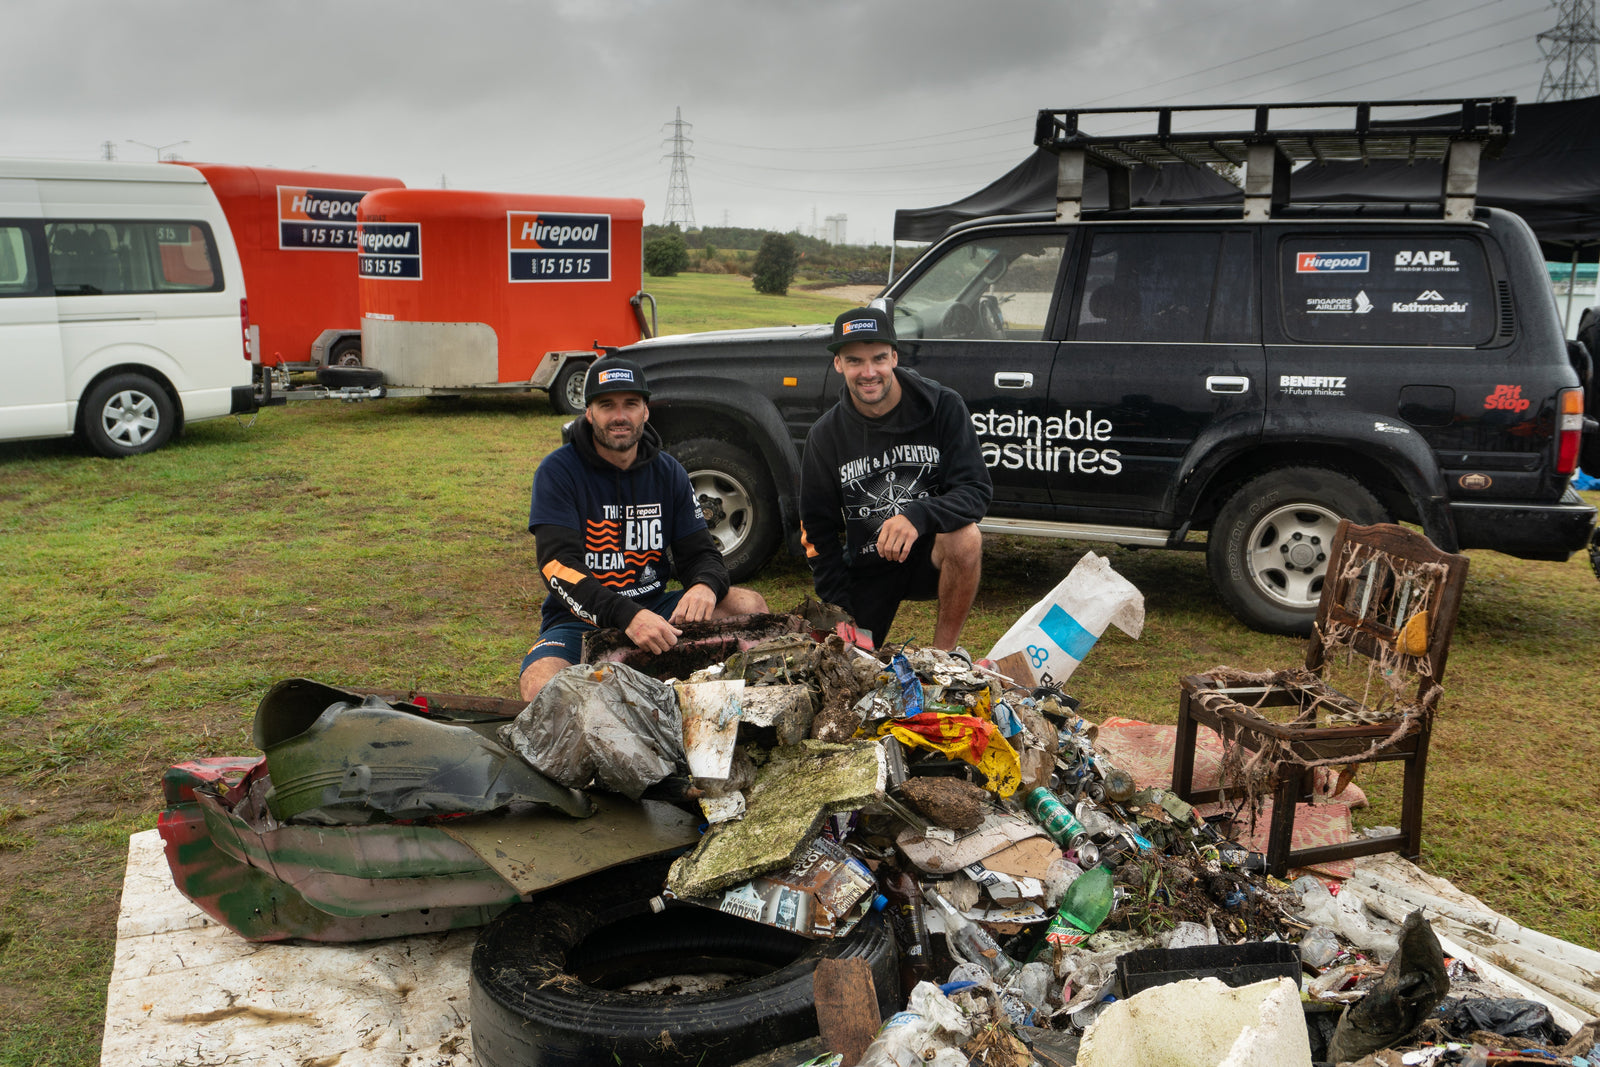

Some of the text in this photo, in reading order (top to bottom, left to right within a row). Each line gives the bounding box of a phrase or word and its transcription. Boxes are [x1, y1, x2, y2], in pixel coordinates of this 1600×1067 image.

[311, 228, 327, 244] 15
[329, 229, 344, 244] 15
[521, 221, 599, 246] Hirepool
[540, 258, 555, 274] 15
[558, 258, 573, 274] 15
[576, 258, 591, 274] 15
[1303, 256, 1363, 270] Hirepool
[1411, 251, 1458, 266] APL
[375, 259, 386, 273] 15
[388, 260, 401, 274] 15
[1392, 302, 1466, 313] Kathmandu
[846, 321, 874, 332] Hirepool
[601, 371, 631, 381] Hirepool
[1280, 375, 1347, 388] BENEFITZ
[1288, 387, 1313, 396] Future
[1493, 384, 1522, 401] Pit
[1484, 395, 1531, 414] Stop
[839, 456, 871, 483] SHING
[873, 457, 881, 469] &
[625, 518, 663, 550] BIG
[585, 552, 625, 570] CLEAN
